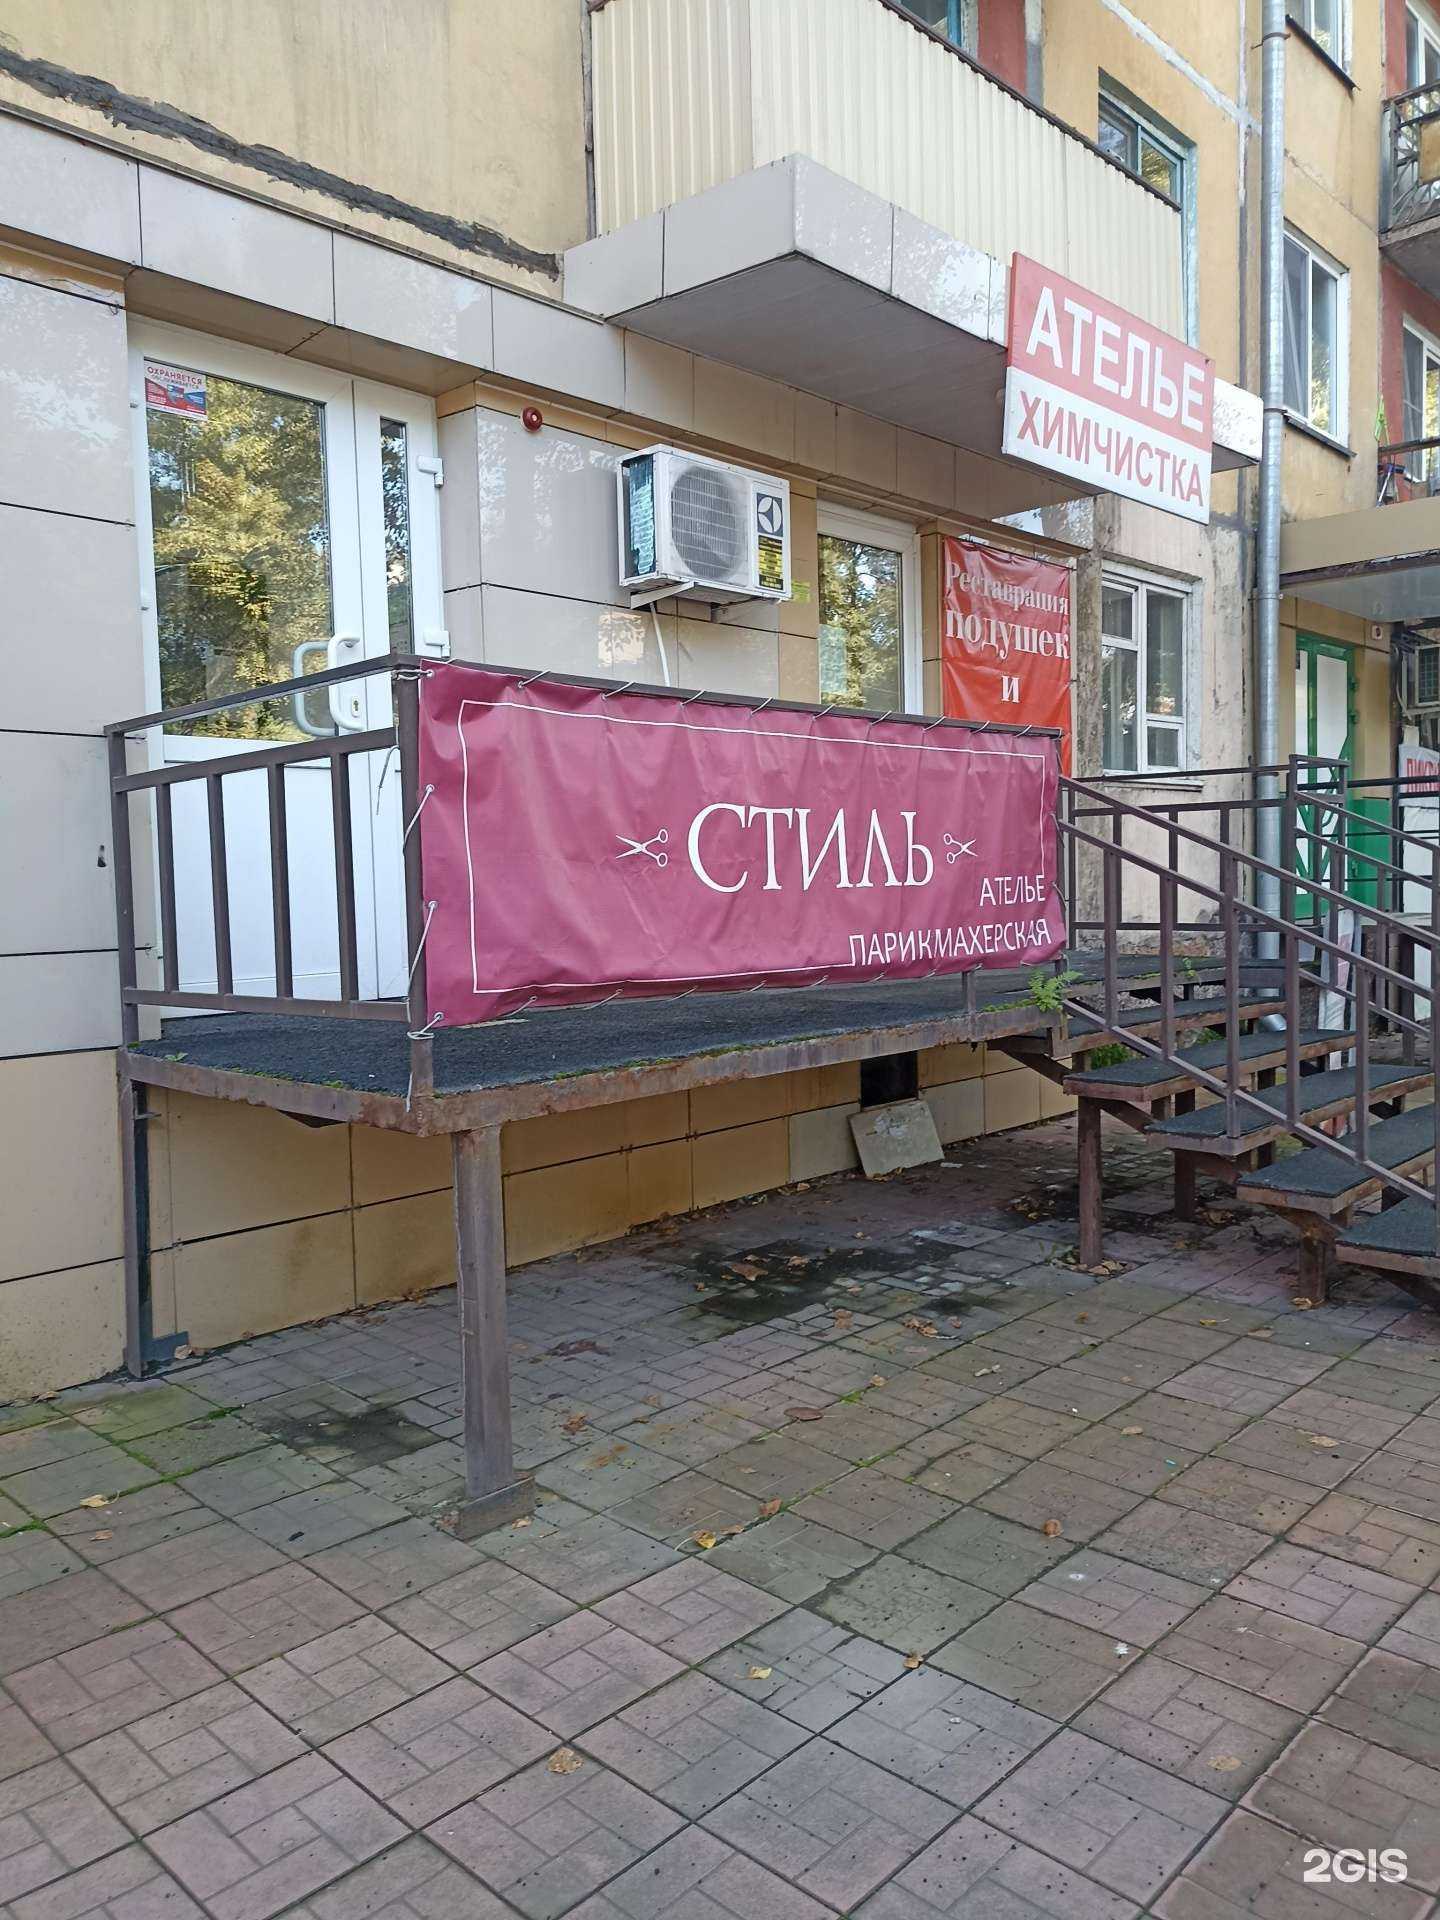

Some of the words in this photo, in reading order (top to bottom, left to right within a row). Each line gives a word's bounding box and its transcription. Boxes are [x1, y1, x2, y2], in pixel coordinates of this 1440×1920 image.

[147, 366, 202, 385] ОХРАНЯЕТСЯ
[1026, 285, 1205, 433] АТЕЛЬЕ
[1017, 390, 1204, 507] ХИМЧИСТКА
[945, 562, 1069, 615] Реставрация
[945, 609, 1070, 660] подушек
[687, 802, 935, 893] СТИЛЬ
[979, 875, 1045, 907] АТЕЛЬЕ
[849, 918, 1052, 966] ПАРИКМАХЕРСКАЯ
